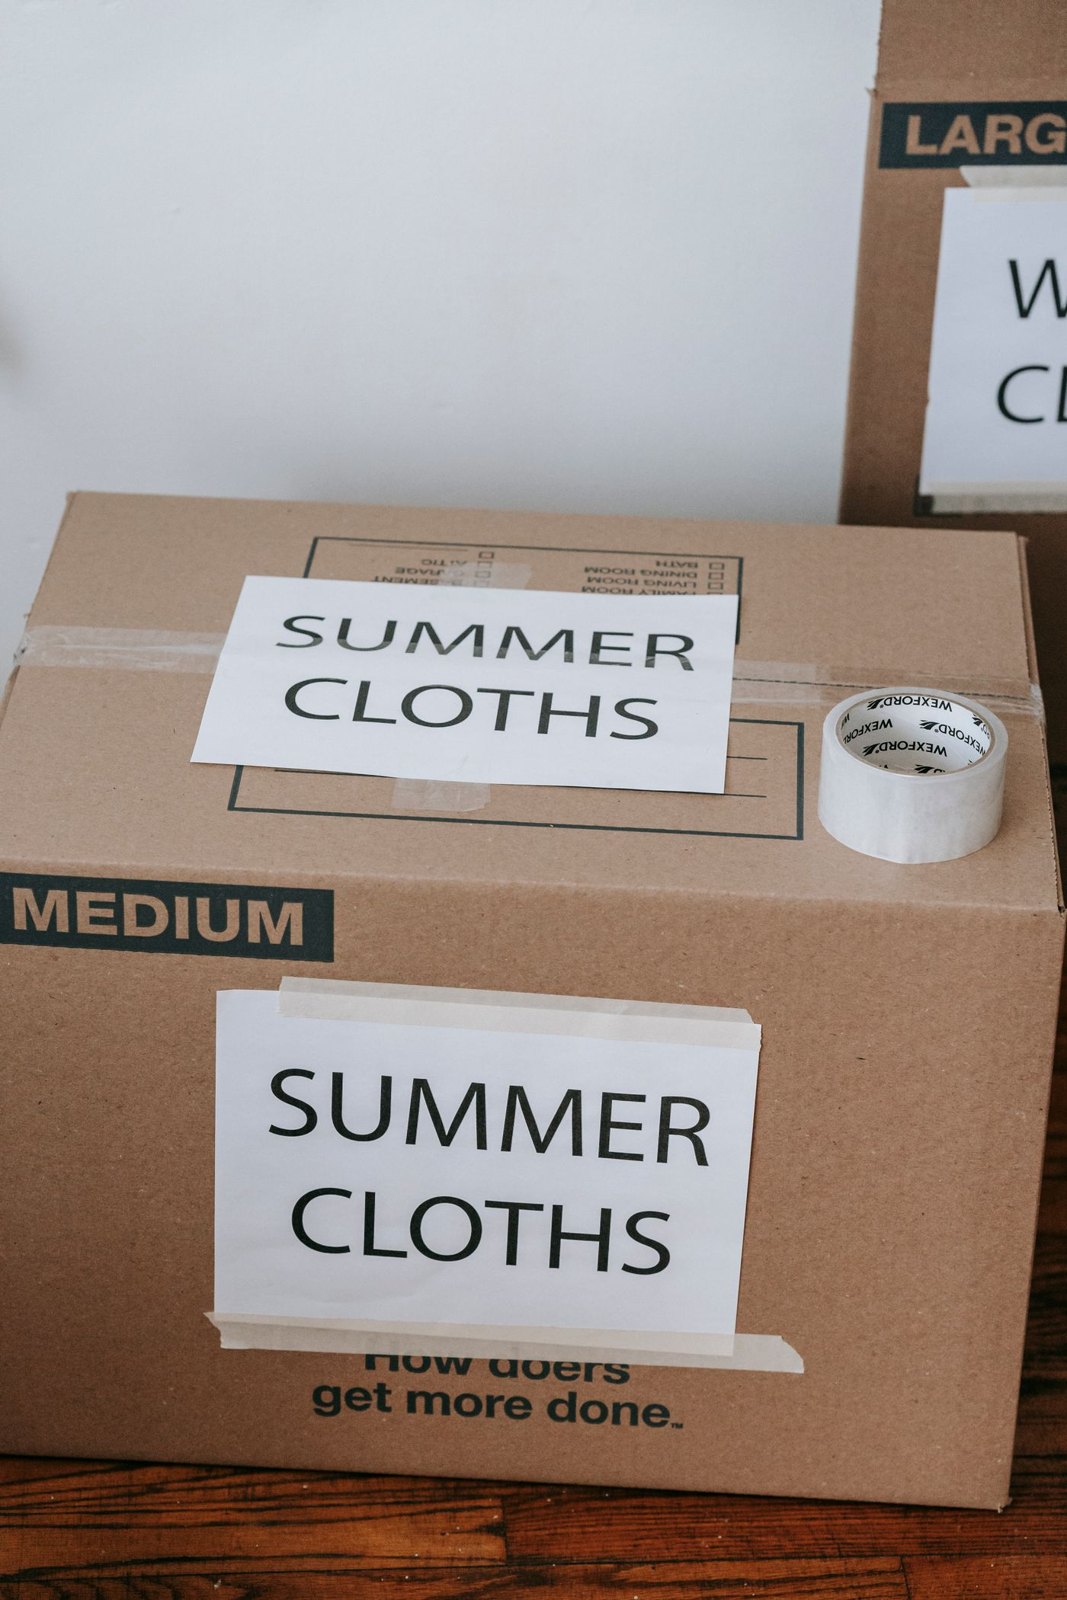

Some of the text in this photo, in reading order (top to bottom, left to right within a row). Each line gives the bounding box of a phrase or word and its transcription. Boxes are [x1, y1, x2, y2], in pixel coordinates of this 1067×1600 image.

[905, 112, 1067, 156] LARG
[373, 575, 464, 586] SEMENT
[395, 566, 465, 577] RAGE
[584, 566, 698, 579] DINING ROOM
[587, 576, 697, 589] LIVING ROOM
[655, 560, 699, 569] BATH
[581, 585, 634, 595] ROOM
[275, 614, 696, 672] SUMMER
[283, 676, 660, 741] CLOTHS
[12, 886, 304, 947] MEDIUM
[268, 1067, 712, 1168] SUMMER
[290, 1186, 672, 1276] CLOTHS
[311, 1382, 393, 1418] get
[405, 1387, 533, 1421] more
